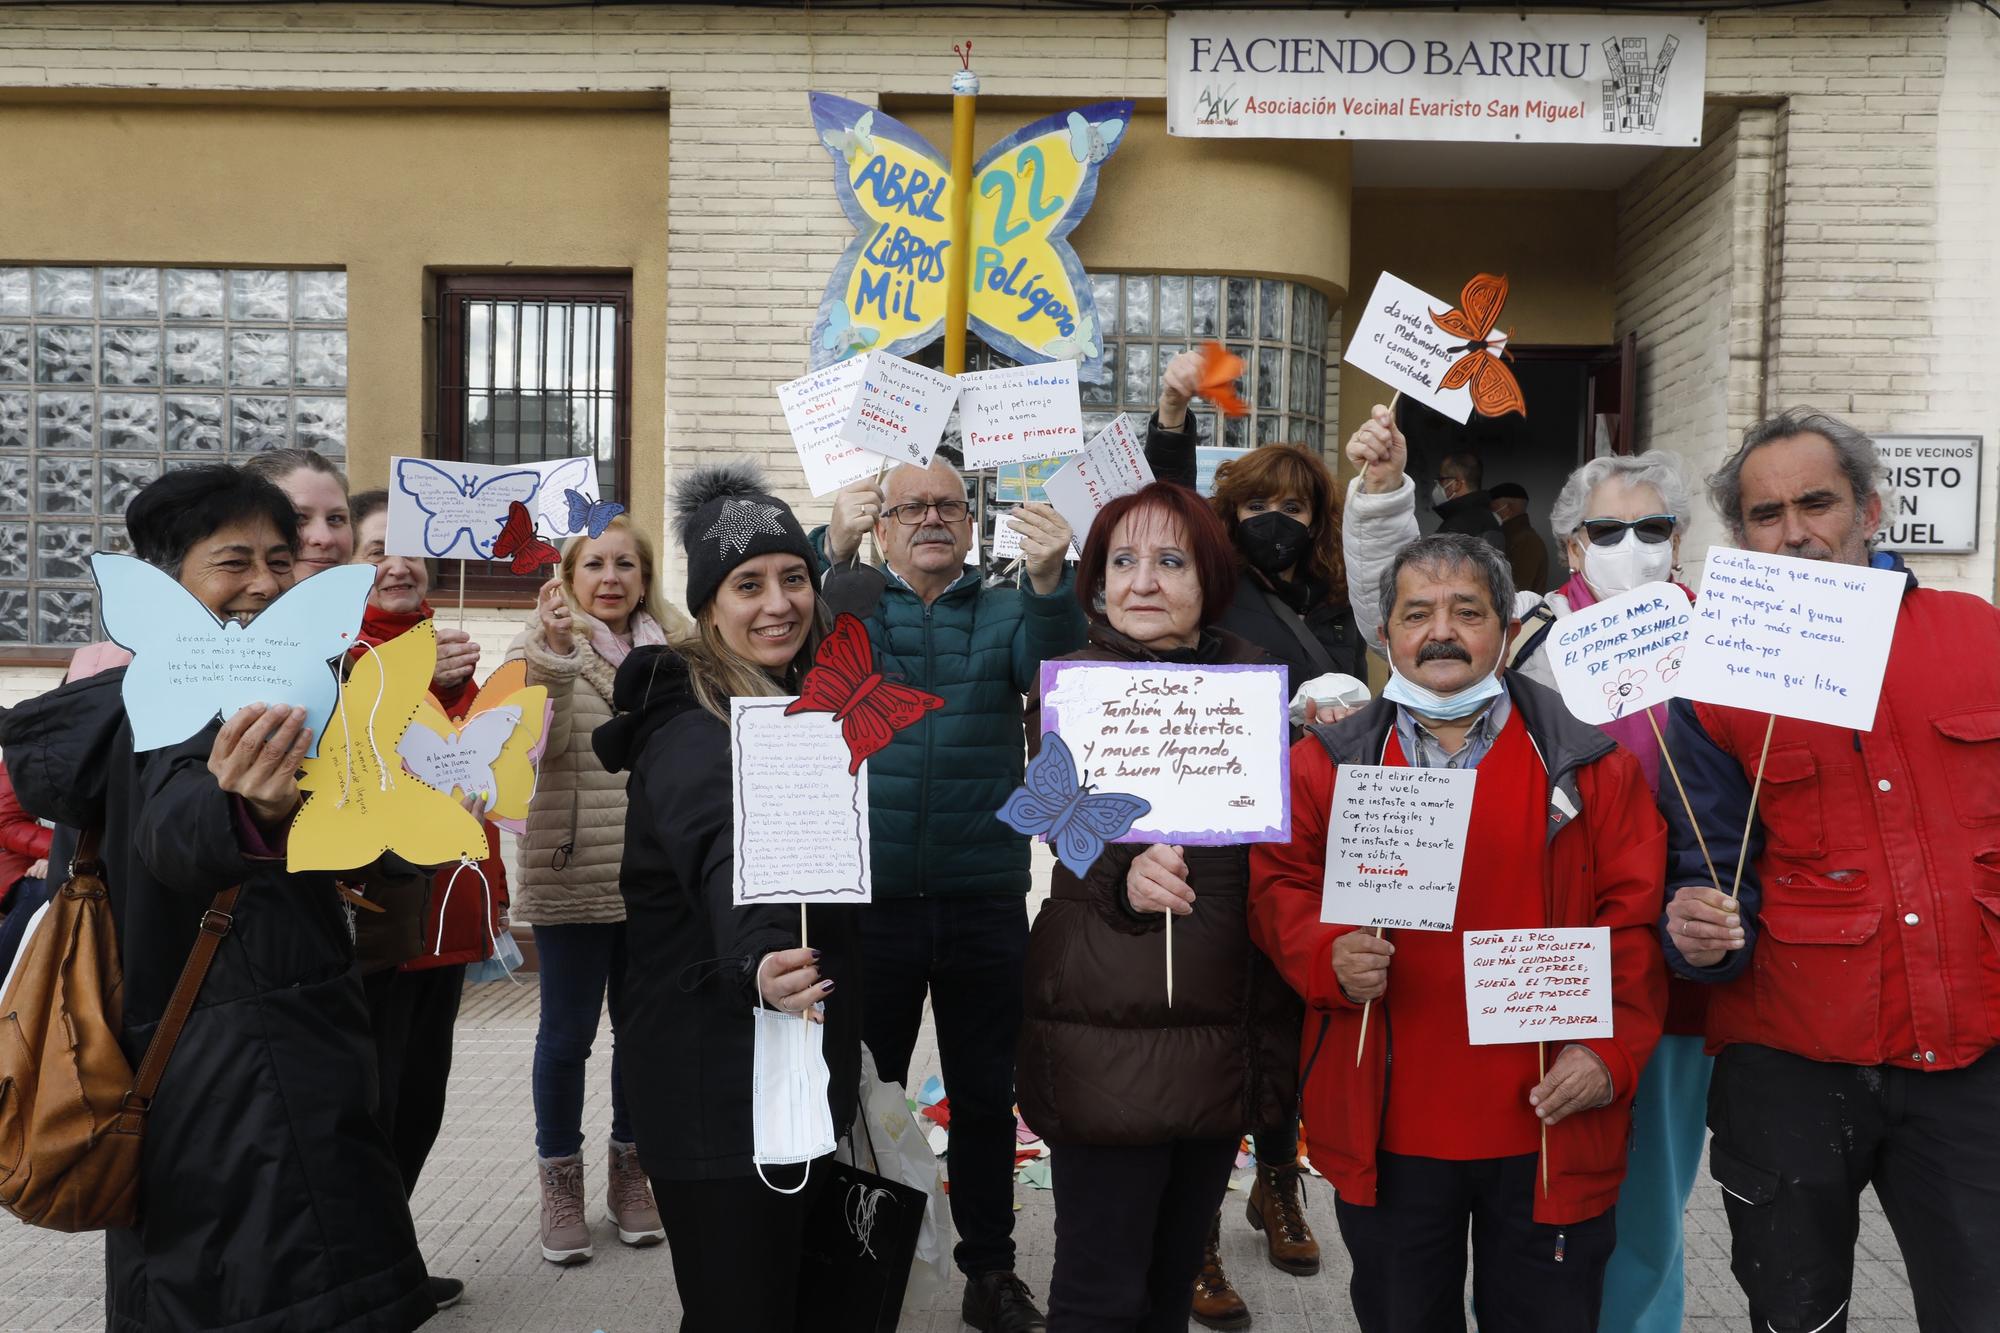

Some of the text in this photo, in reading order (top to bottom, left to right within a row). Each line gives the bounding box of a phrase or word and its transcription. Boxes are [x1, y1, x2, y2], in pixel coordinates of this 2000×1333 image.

[1190, 38, 1591, 79] FACIENDO BARRIU
[1245, 95, 1585, 122] Asociación Vecinal Evaristo San Miguel
[981, 146, 1064, 246] 22
[974, 246, 1074, 336] Polígono
[1403, 314, 1422, 328] vida
[1424, 324, 1433, 335] es
[1387, 341, 1418, 361] cambio
[1421, 359, 1430, 368] es
[798, 376, 841, 396] certeza
[880, 371, 926, 397] Mariposas
[890, 362, 928, 380] primavera
[932, 377, 951, 392] trajo
[963, 386, 980, 395] para
[1002, 380, 1023, 388] días
[1027, 376, 1069, 386] helados
[806, 397, 837, 415] abril
[863, 398, 903, 422] Tardecitas
[977, 398, 1051, 414] Aquel petirrojo
[861, 408, 908, 433] soleadas
[1009, 413, 1037, 421] asoma
[971, 427, 1076, 446] Parece primavera
[1114, 423, 1123, 435] me
[1120, 438, 1142, 481] quisieron
[1895, 448, 1912, 457] DE
[1916, 448, 1973, 457] VECINOS
[1711, 572, 1737, 583] como
[1713, 555, 1837, 587] Cuénta-yos que nun
[1706, 589, 1725, 601] que
[1790, 604, 1801, 614] al
[1560, 598, 1669, 646] GOTAS DE AMOR,
[1701, 608, 1845, 643] del pitu más encesu.
[1565, 615, 1689, 666] EL PRIMER DESHIELO
[1705, 635, 1781, 658] Cuénta-yos
[1587, 660, 1609, 675] DE
[1126, 676, 1204, 696] ¿Sabes?
[1727, 663, 1750, 675] que
[1756, 670, 1776, 679] nun
[1815, 674, 1848, 697] libre
[1102, 698, 1243, 726] También hay vida
[1101, 718, 1252, 736] en los desiertos.
[1101, 746, 1150, 757] naves
[1094, 756, 1247, 779] a buen puerto.
[1350, 769, 1450, 784] Con el elixir eterno
[1358, 782, 1419, 794] de tu vuelo
[1347, 797, 1364, 805] me
[1369, 797, 1405, 807] instaste
[1421, 799, 1454, 809] amarte
[1343, 810, 1360, 820] Con
[1365, 811, 1379, 820] tus
[1430, 816, 1435, 825] y
[1384, 825, 1413, 835] labios
[1362, 837, 1399, 846] instaste
[1416, 838, 1454, 849] besarte
[1368, 850, 1401, 860] súbita
[1357, 863, 1409, 876] traición
[1358, 879, 1402, 893] obligaste
[1419, 881, 1455, 892] odiarte
[1371, 917, 1412, 927] ANTONIO
[1470, 934, 1504, 945] SUEÑA
[1528, 933, 1554, 942] RICO
[1536, 942, 1596, 952] RIQUEZA,
[1473, 955, 1575, 966] QUE MÁS CUIDADOS
[1518, 964, 1588, 974] LE OFRECE;
[1475, 976, 1590, 988] SUEÑA EL POBRE
[1507, 989, 1591, 1001] QUE PADECE
[1504, 1005, 1557, 1013] MISERIA
